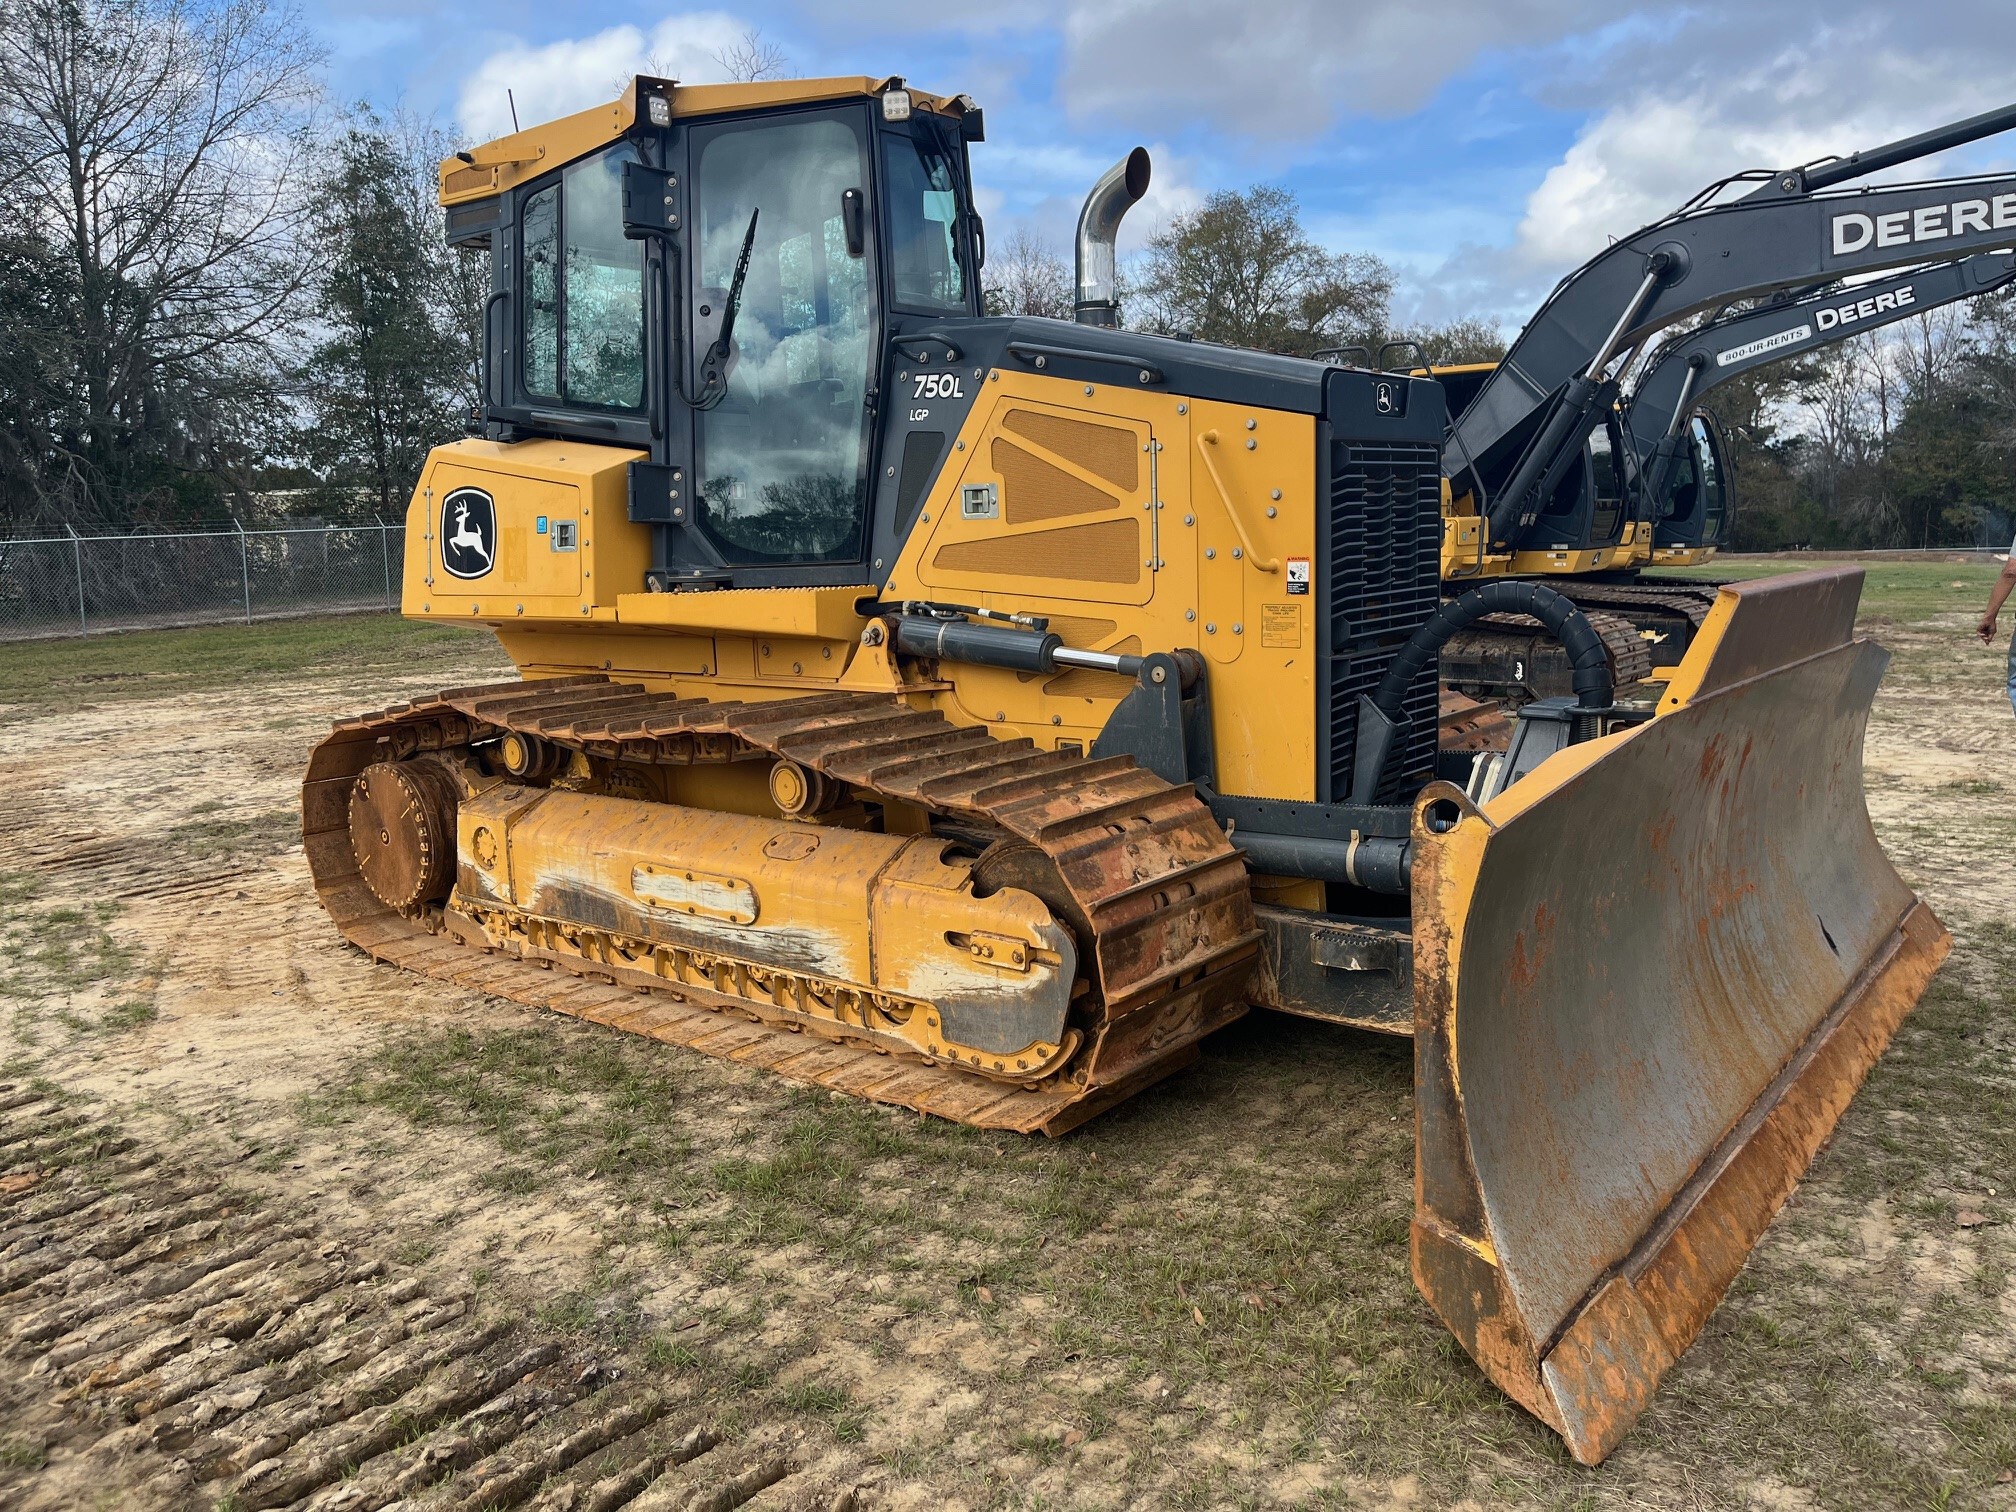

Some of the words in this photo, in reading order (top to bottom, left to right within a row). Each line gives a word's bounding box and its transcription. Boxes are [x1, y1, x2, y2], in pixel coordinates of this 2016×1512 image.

[1832, 192, 2016, 255] DEERE
[1815, 285, 1916, 332] DEERE
[1724, 329, 1804, 362] 800-UR-RENTS
[912, 373, 964, 398] 750L
[909, 408, 930, 421] LGP
